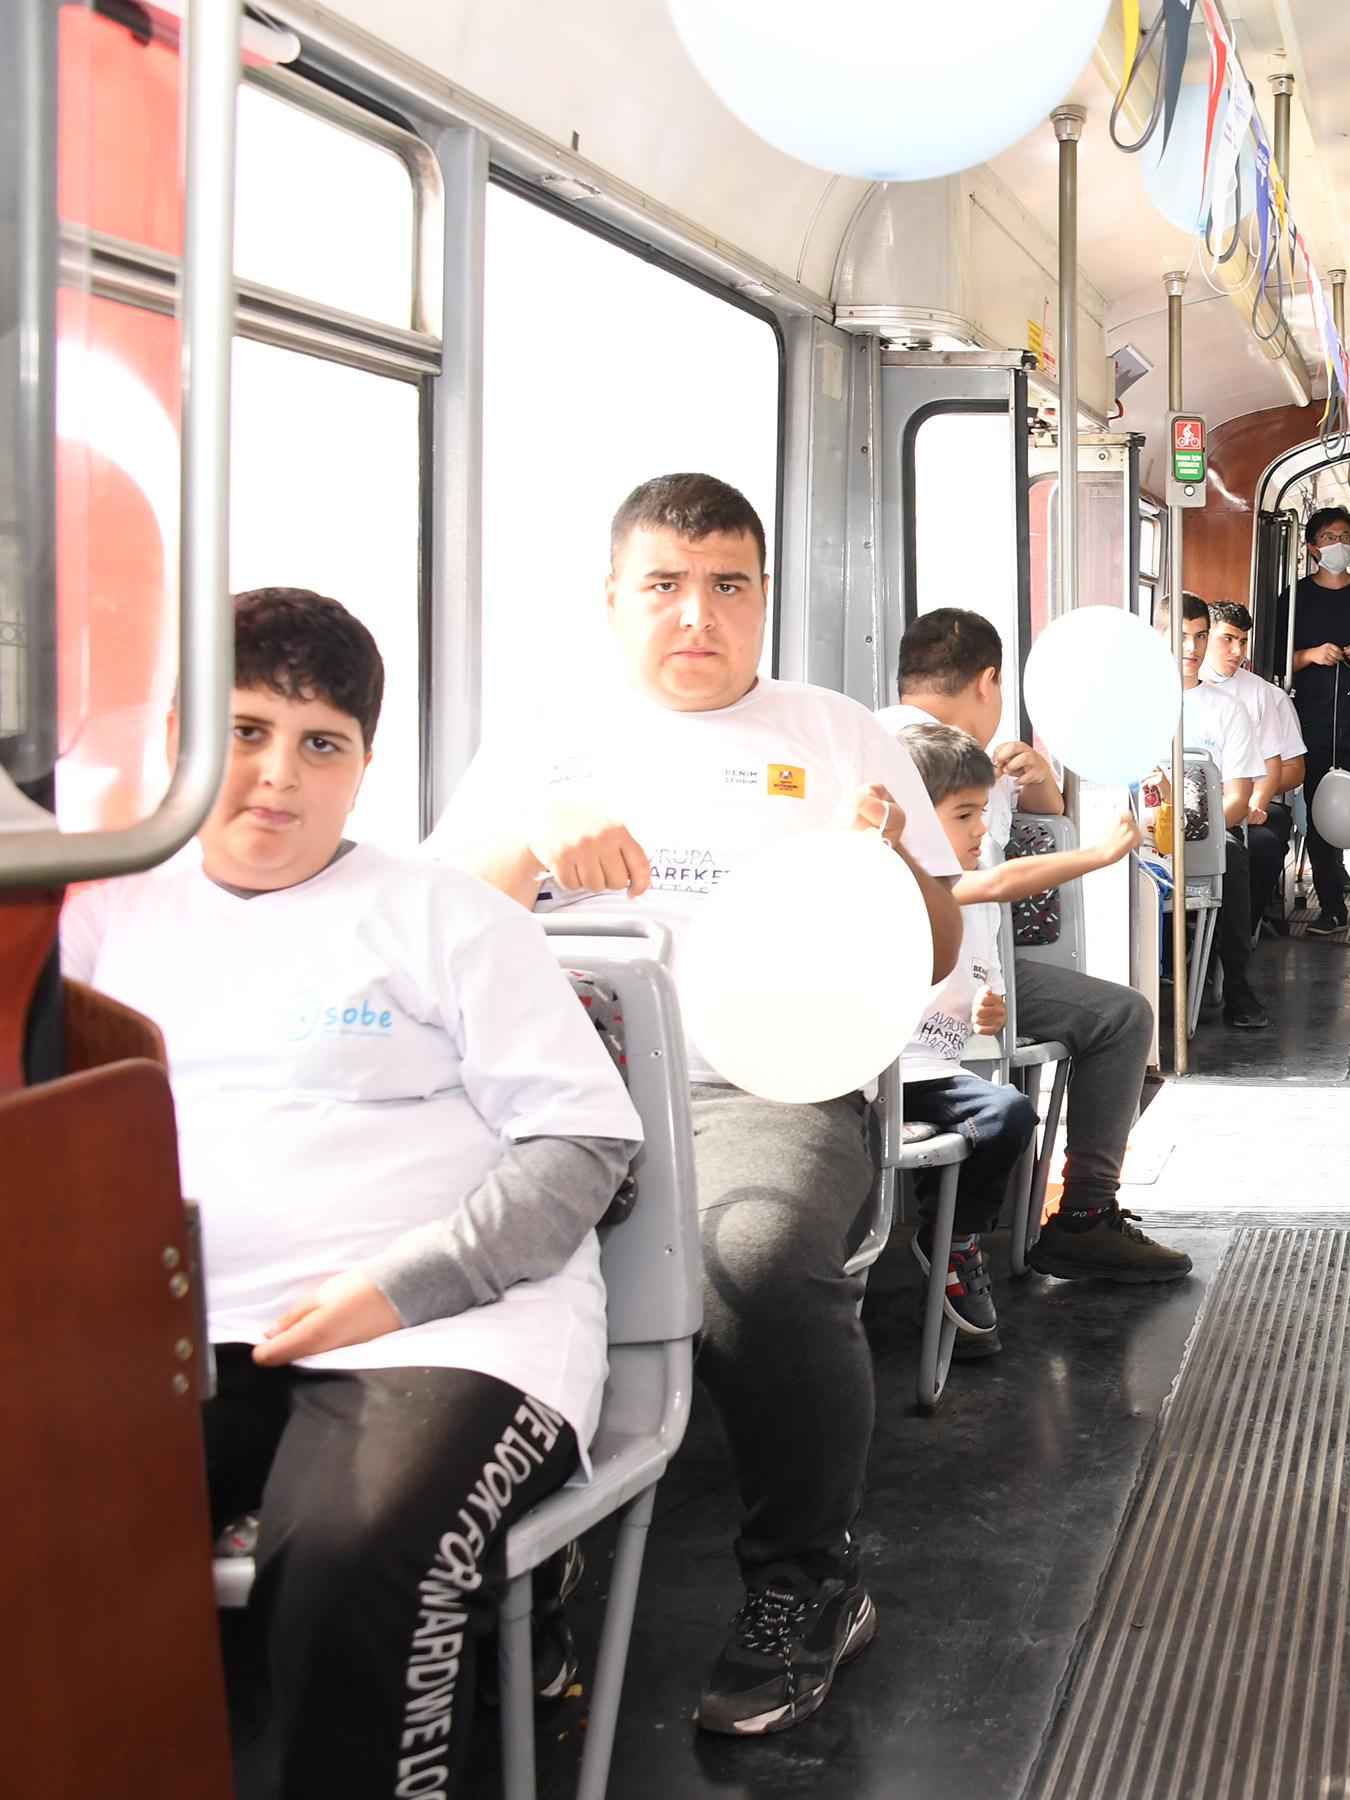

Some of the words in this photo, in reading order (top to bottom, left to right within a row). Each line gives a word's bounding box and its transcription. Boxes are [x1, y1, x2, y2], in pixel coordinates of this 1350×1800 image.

[324, 999, 392, 1029] sobe
[466, 1426, 544, 1532] LOOK
[395, 1744, 450, 1800] LO
